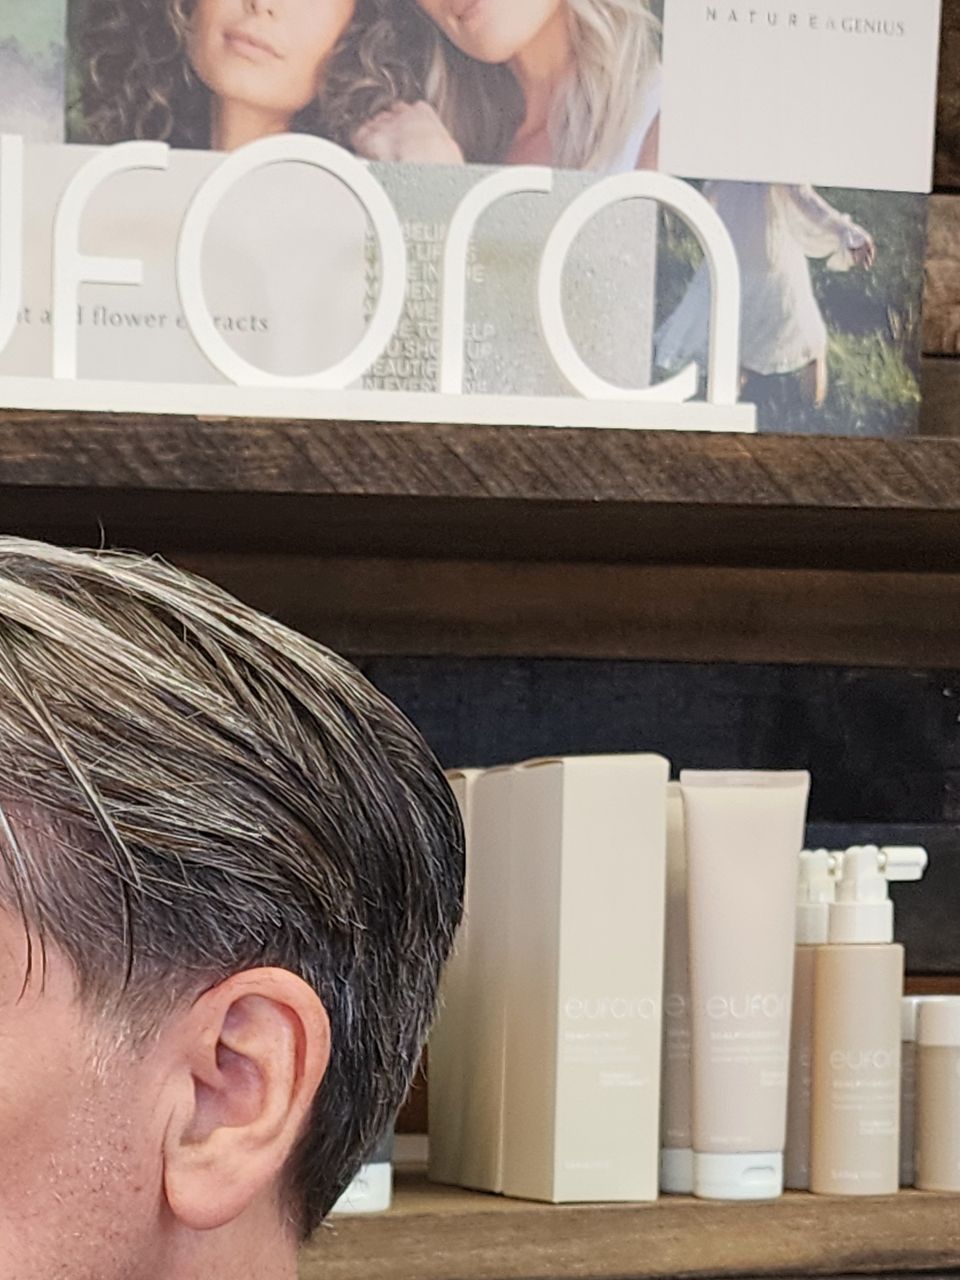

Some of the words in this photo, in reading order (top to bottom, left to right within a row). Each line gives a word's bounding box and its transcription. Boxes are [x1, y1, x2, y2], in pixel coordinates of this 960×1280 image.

[705, 6, 822, 30] NATURE
[841, 17, 906, 36] GENIUS
[92, 303, 168, 328] flower
[175, 309, 269, 334] eracts
